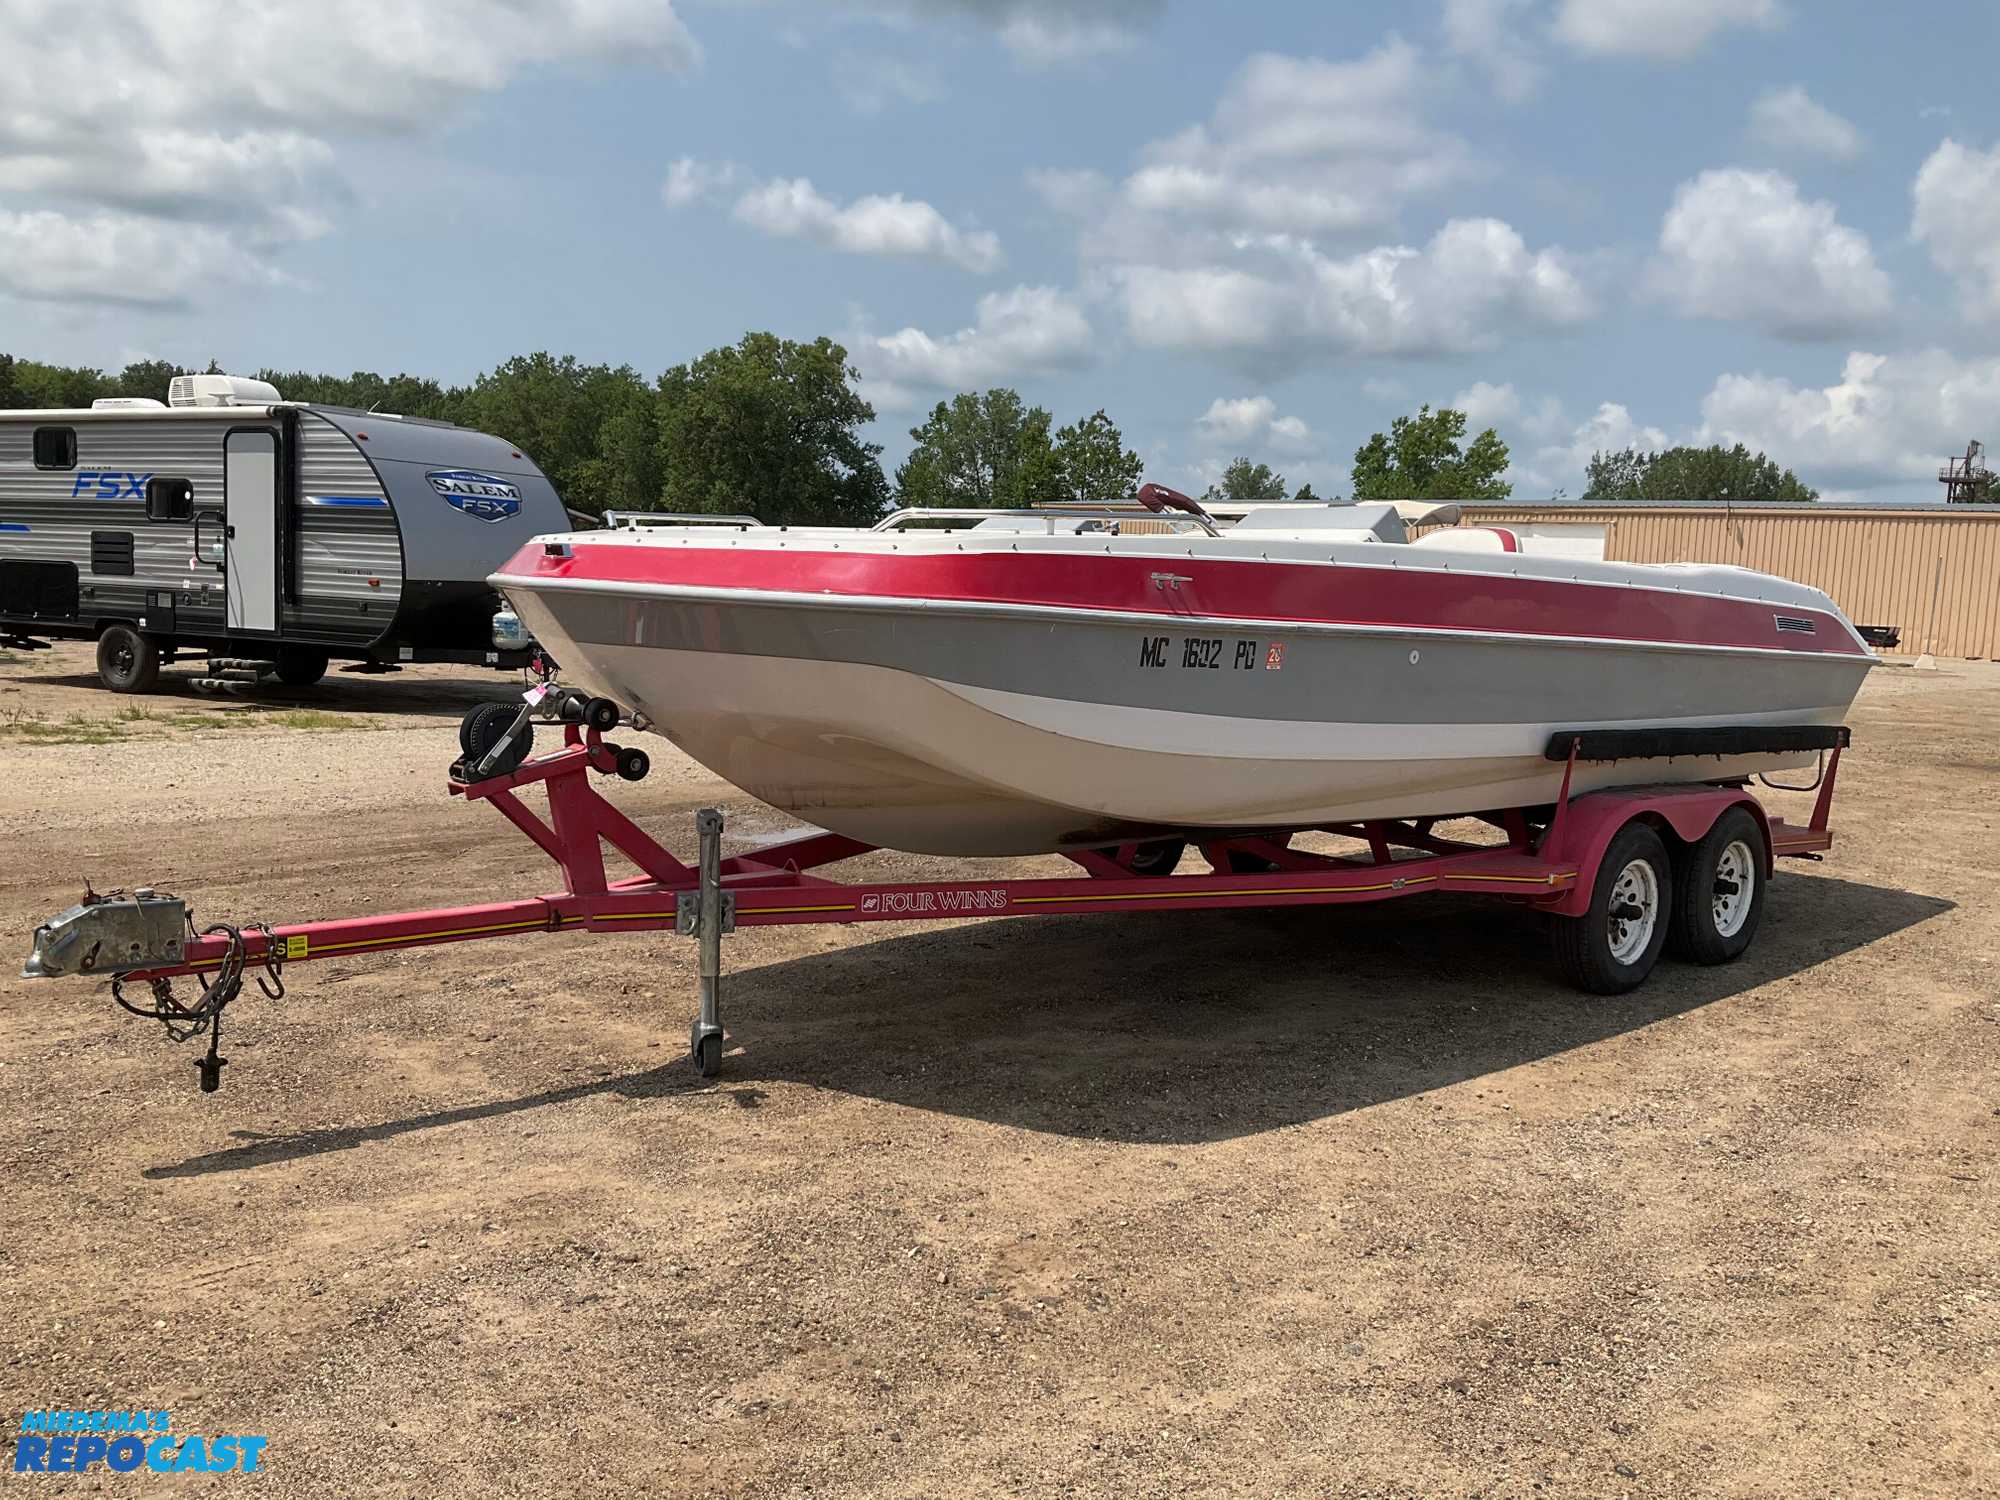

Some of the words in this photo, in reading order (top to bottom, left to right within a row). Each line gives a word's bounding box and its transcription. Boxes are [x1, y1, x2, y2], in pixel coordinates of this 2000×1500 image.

[72, 472, 154, 499] FSX
[432, 479, 519, 499] SALEM
[462, 499, 509, 514] FSX
[1139, 637, 1170, 668] MC
[881, 892, 937, 912] FOUR
[937, 889, 1008, 911] WINNS
